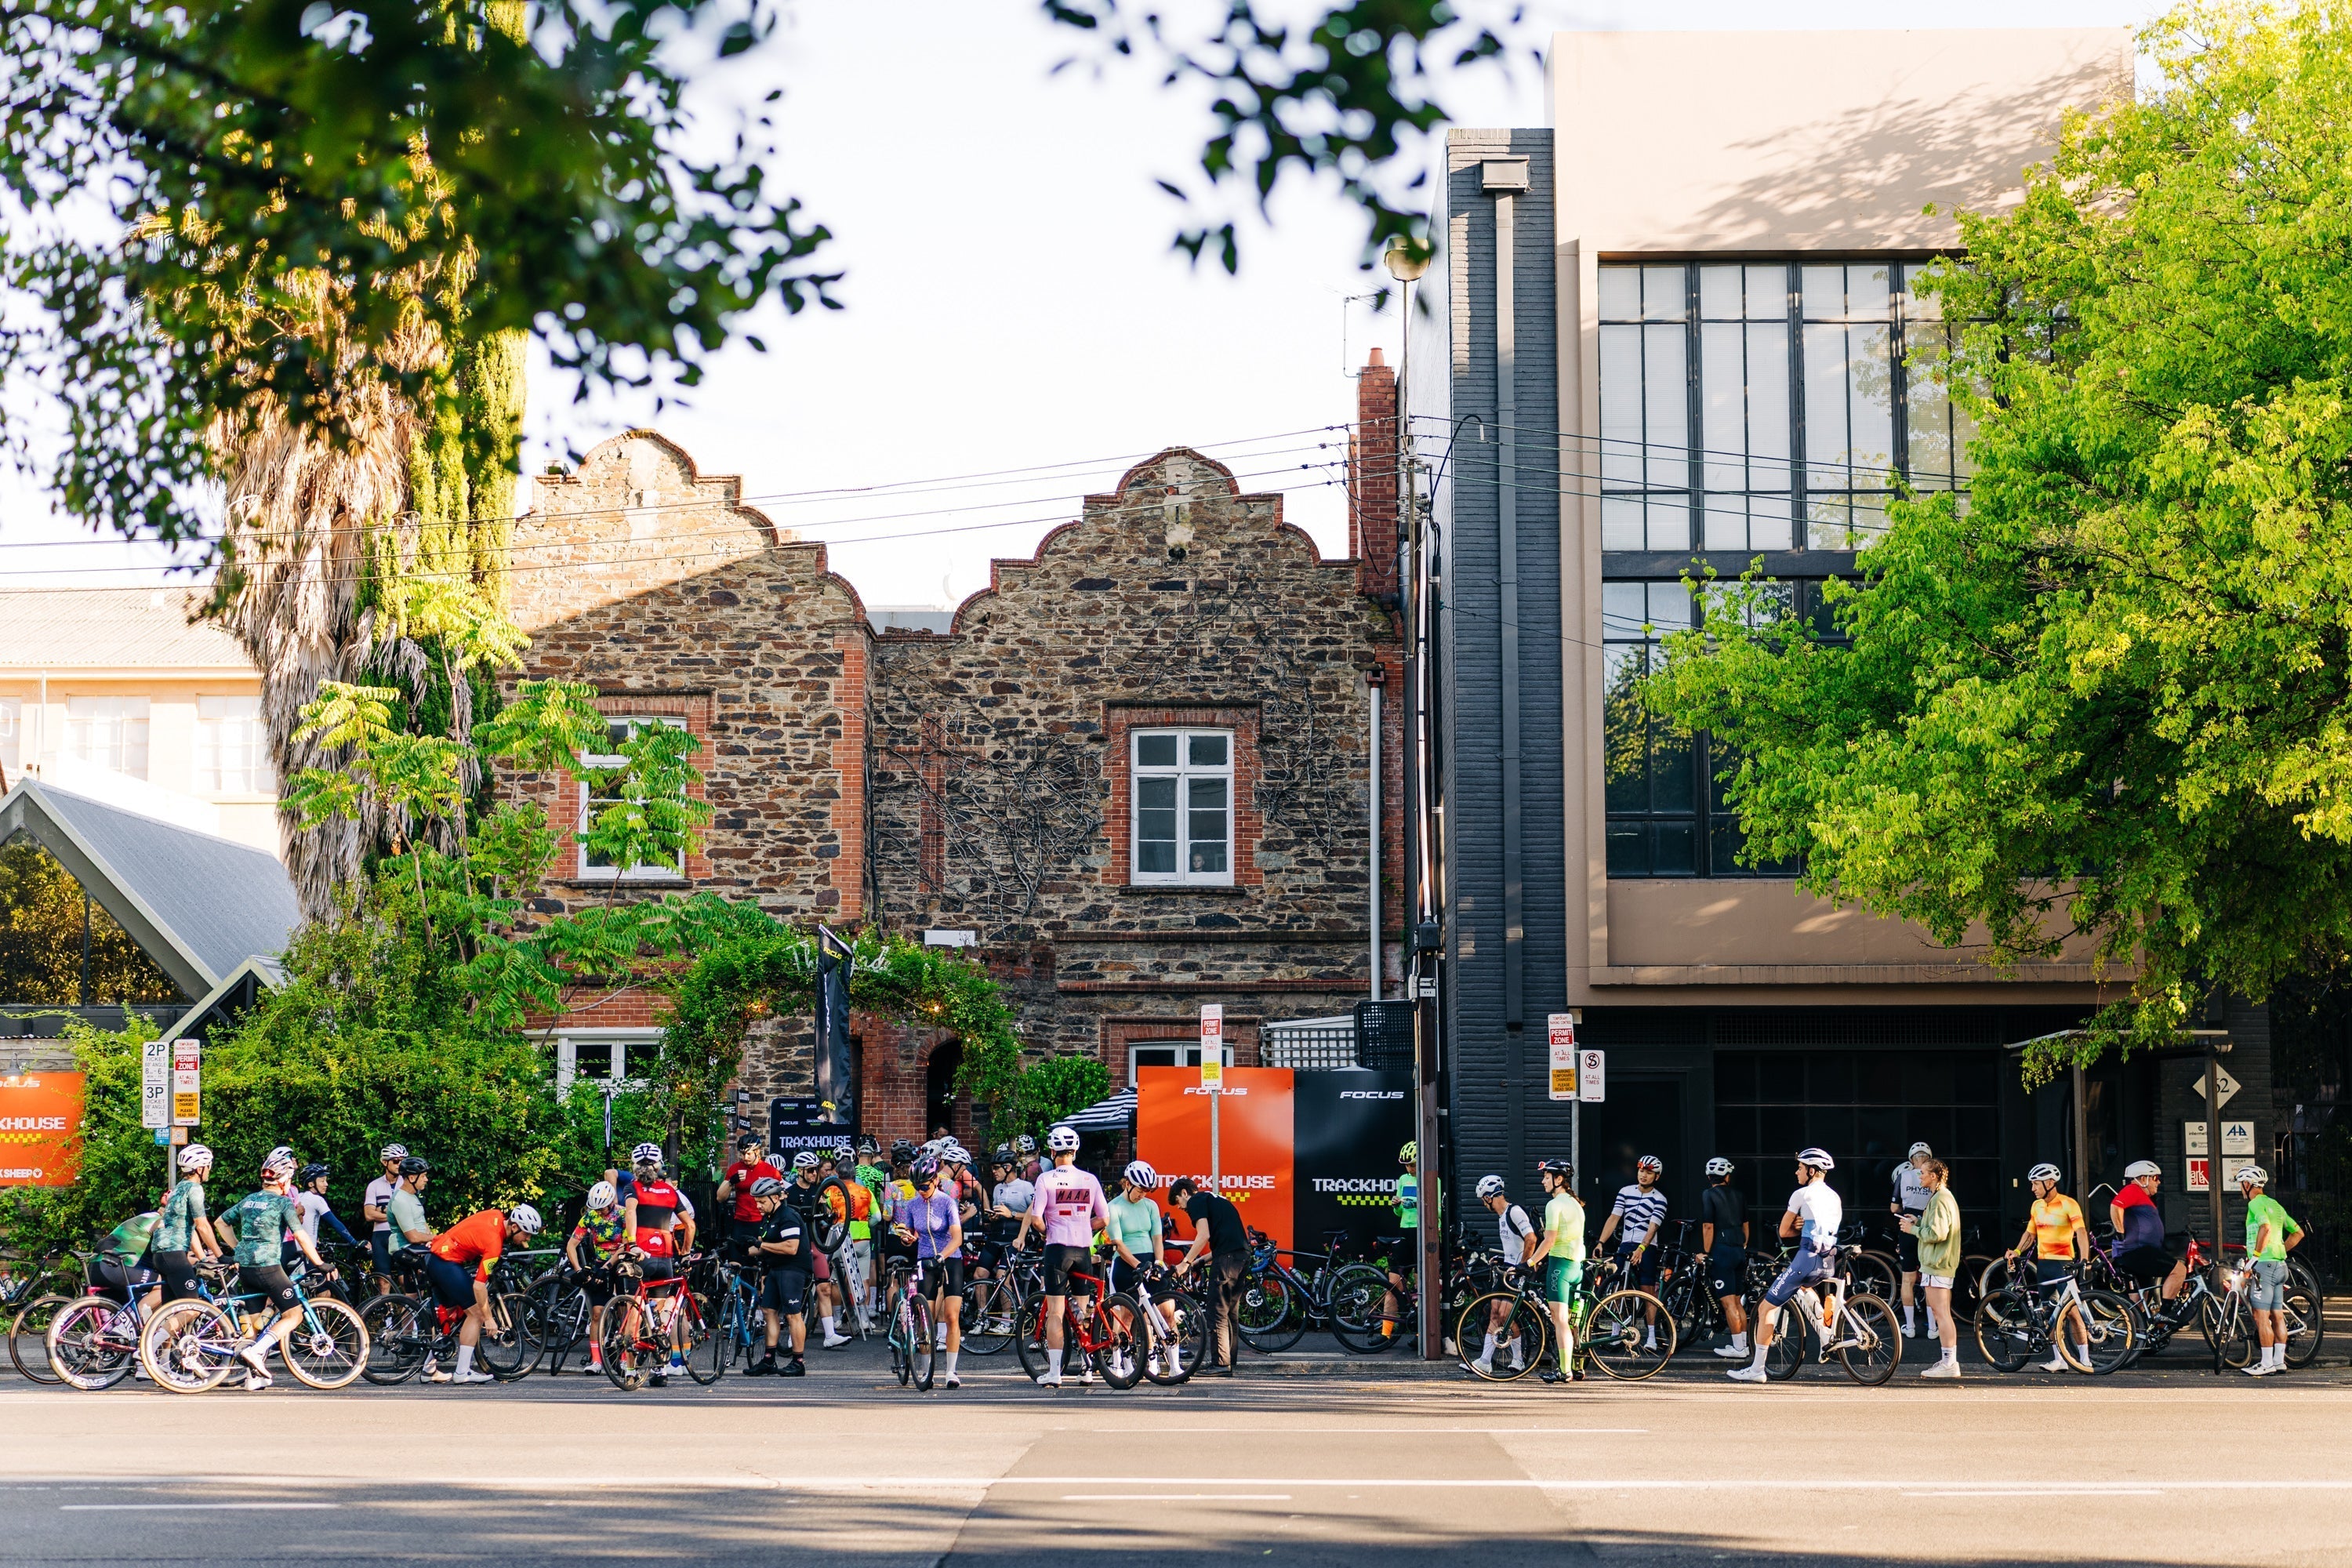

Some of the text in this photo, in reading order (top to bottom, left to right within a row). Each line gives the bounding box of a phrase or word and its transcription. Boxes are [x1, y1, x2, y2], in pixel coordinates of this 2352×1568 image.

[823, 946, 843, 960] FOCUS
[147, 1044, 165, 1056] 2P
[147, 1087, 164, 1098] 3P
[779, 1135, 851, 1148] TRACKHOUSE
[4, 1169, 33, 1178] SHEEP
[1058, 1191, 1090, 1201] MAAP
[1552, 1269, 1561, 1292] pedla
